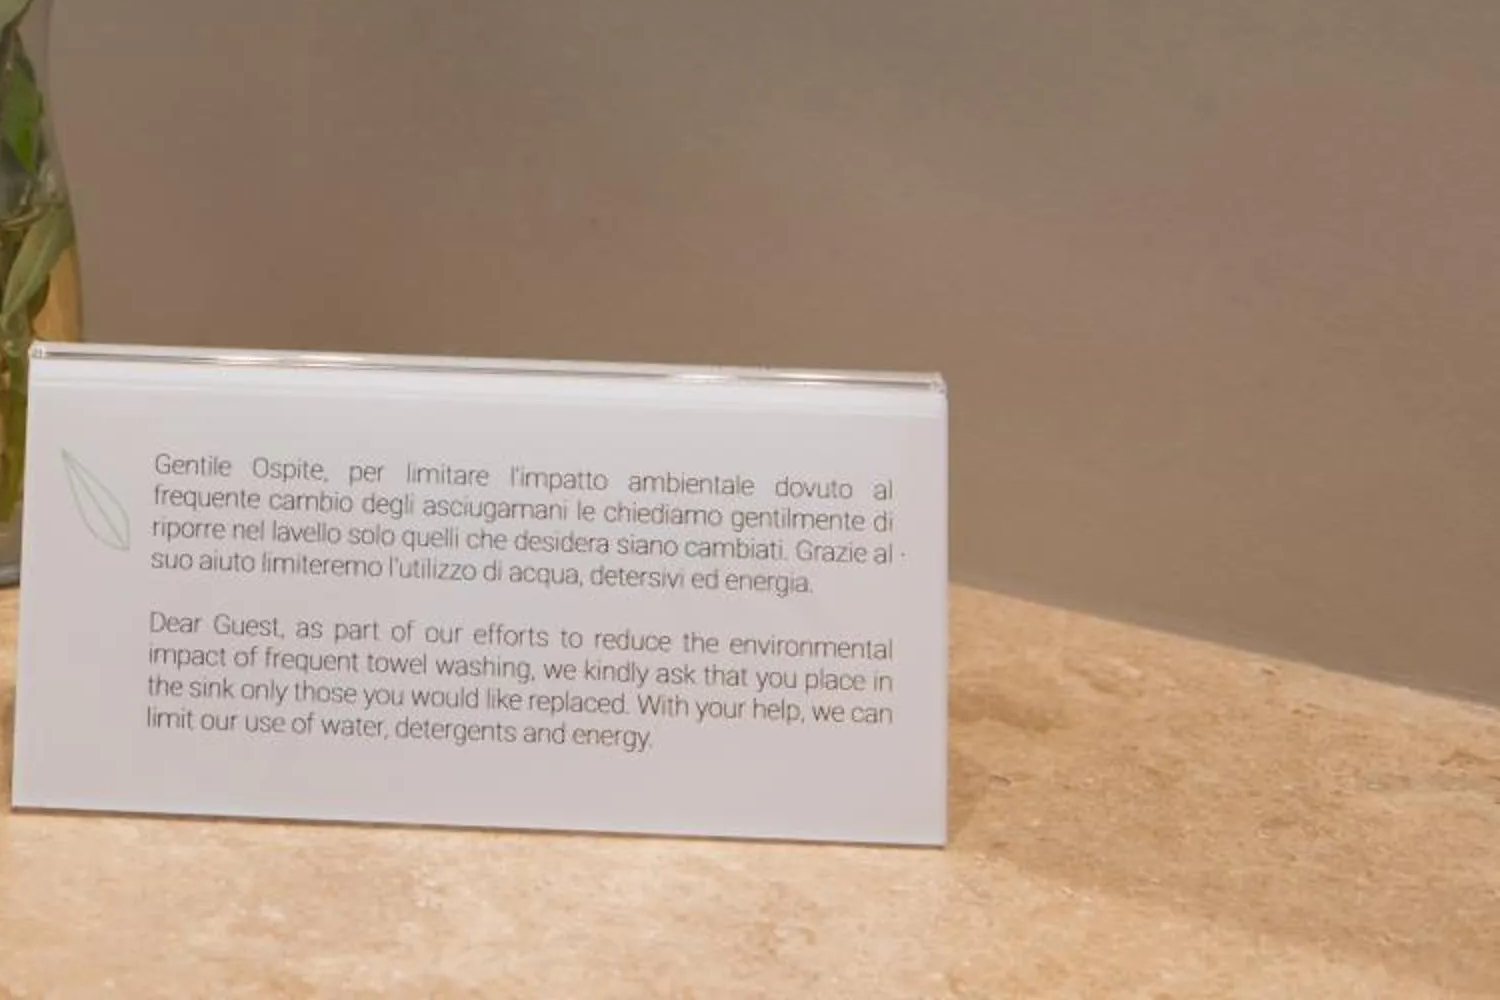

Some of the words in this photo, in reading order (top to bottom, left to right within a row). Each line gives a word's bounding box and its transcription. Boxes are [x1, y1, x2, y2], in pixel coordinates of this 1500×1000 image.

[154, 452, 233, 479] Gentile
[251, 455, 330, 485] Ospite,
[348, 463, 385, 489] per
[405, 461, 491, 488] limitare
[510, 463, 610, 494] l'impatto
[627, 470, 756, 498] ambientale
[774, 474, 854, 501] dovuto
[872, 477, 893, 502] al
[153, 482, 261, 513] frequente
[268, 489, 355, 514] cambio
[361, 491, 415, 522] degli
[422, 497, 568, 525] asciugamani
[576, 499, 597, 524] le
[603, 500, 724, 529] chiediamo
[730, 506, 866, 534] gentilmente
[872, 508, 894, 534] di
[152, 515, 227, 544] riporre
[231, 519, 265, 543] nel
[271, 518, 343, 545] lavello
[346, 522, 396, 548] solo
[400, 526, 459, 553] quelli
[465, 527, 509, 553] che
[512, 528, 613, 556] desidera
[616, 533, 680, 558] siano
[683, 536, 788, 562] cambiati.
[794, 537, 868, 565] Grazie
[872, 541, 894, 567] al
[150, 550, 194, 573] suo
[198, 548, 256, 575] aiuto
[261, 550, 384, 579] limiteremo
[388, 554, 478, 585] l'utilizzo
[482, 558, 503, 583] di
[508, 563, 584, 590] acqua,
[589, 563, 685, 591] detersivi
[690, 567, 720, 592] ed
[724, 566, 814, 600] energia.
[149, 609, 204, 635] Dear
[212, 612, 286, 641] Guest,
[295, 619, 324, 641] as
[333, 619, 380, 645] part
[390, 618, 417, 645] of
[424, 624, 465, 646] our
[472, 620, 550, 649] efforts
[559, 627, 584, 650] to
[593, 626, 673, 654] reduce
[682, 630, 720, 656] the
[728, 633, 894, 662] environmental
[148, 641, 227, 672] impact
[233, 644, 259, 670] of
[264, 645, 360, 676] frequent
[366, 651, 428, 676] towel
[435, 654, 536, 686] washing,
[542, 662, 581, 682] we
[583, 657, 650, 690] kindly
[655, 663, 698, 686] ask
[703, 663, 749, 688] that
[755, 670, 798, 694] you
[804, 666, 867, 696] place
[873, 670, 894, 693] in
[147, 673, 184, 698] the
[188, 675, 237, 700] sink
[240, 677, 290, 708] only
[294, 678, 358, 706] those
[362, 686, 405, 712] you
[410, 685, 480, 710] would
[486, 686, 524, 712] like
[526, 689, 631, 718] replaced.
[636, 692, 690, 719] With
[694, 699, 747, 725] your
[752, 696, 805, 728] help,
[811, 703, 846, 724] we
[850, 705, 894, 726] can
[146, 703, 195, 733] limit
[199, 711, 240, 733] our
[244, 714, 287, 735] use
[290, 710, 316, 736] of
[320, 716, 390, 741] water,
[394, 714, 518, 748] detergents
[522, 720, 567, 746] and
[570, 726, 653, 754] energy.
